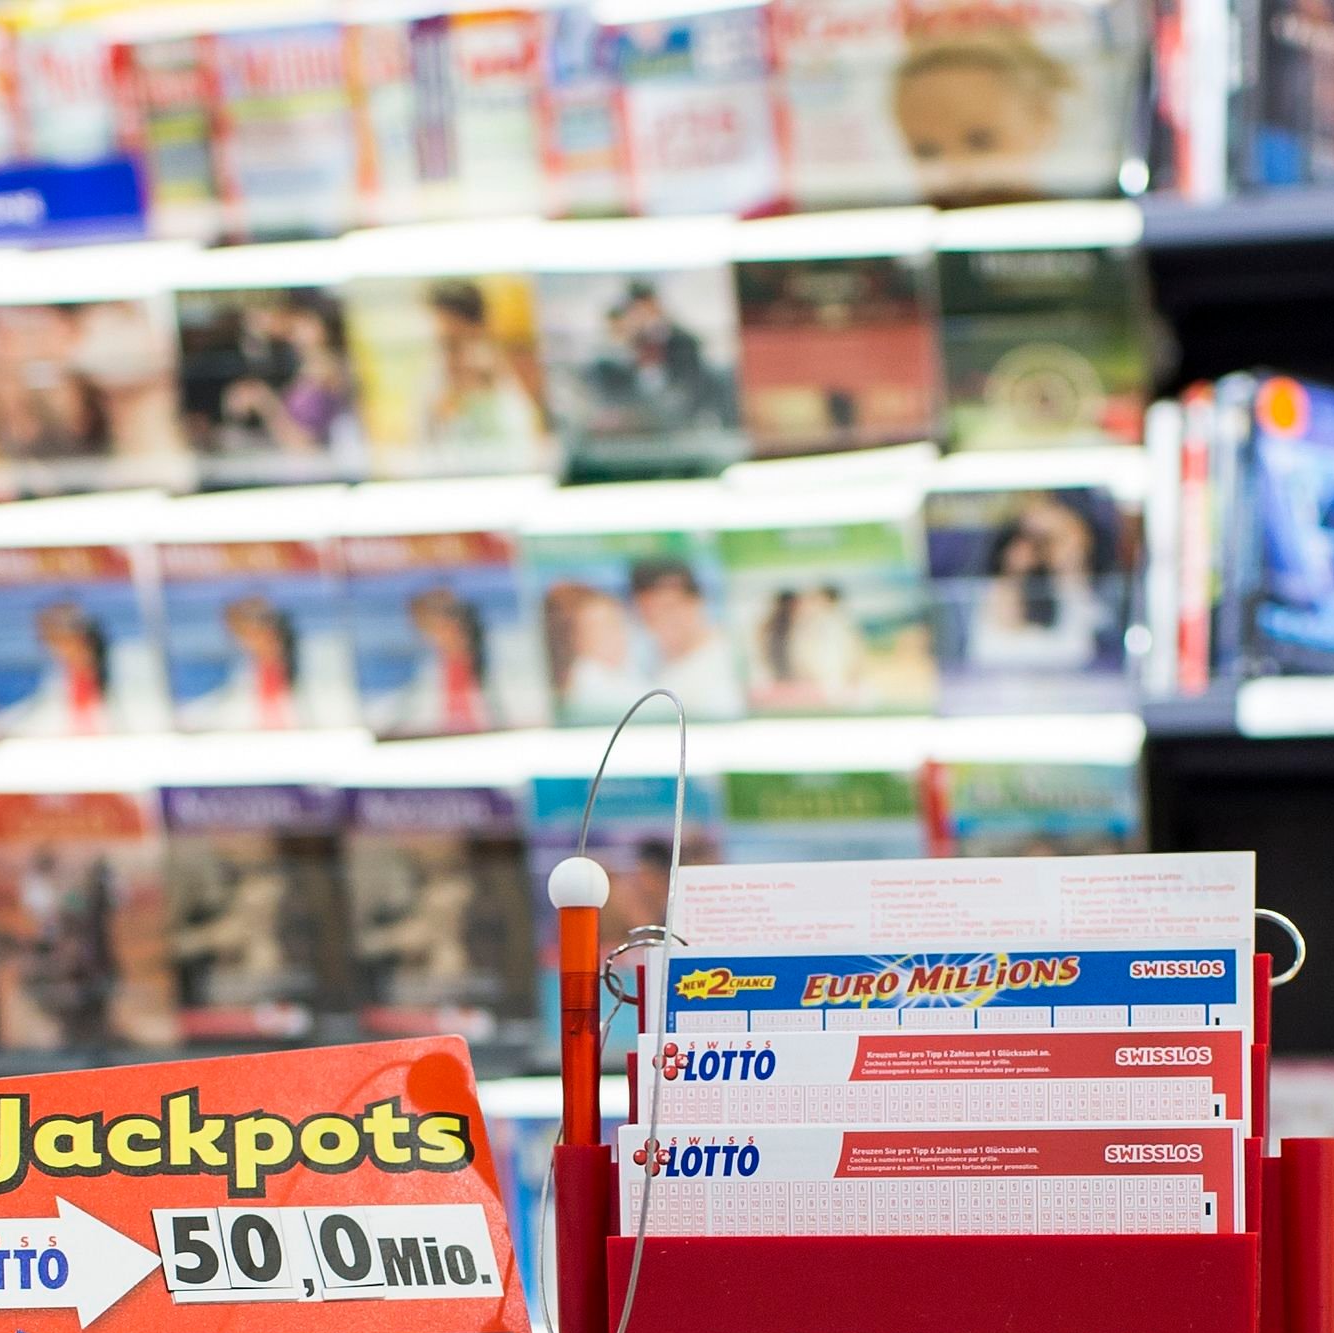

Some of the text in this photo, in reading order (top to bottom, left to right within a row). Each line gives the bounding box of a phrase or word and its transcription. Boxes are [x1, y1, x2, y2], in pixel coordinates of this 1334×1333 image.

[682, 969, 773, 995] NEW 2 CHANCE
[801, 971, 900, 1004] EURO
[1131, 961, 1224, 978] SWISSLOS
[689, 1040, 771, 1050] SWISS
[927, 1051, 942, 1060] Tipp
[949, 1050, 974, 1058] Zahlen
[1116, 1047, 1212, 1065] SWISSLOS
[683, 1049, 776, 1081] LOTTO
[670, 1136, 755, 1146] SWISS
[852, 1147, 883, 1155] Kreuzen
[884, 1147, 896, 1155] Sie
[912, 1147, 929, 1156] Tipp
[936, 1146, 961, 1154] Zahlen
[963, 1146, 977, 1154] und
[1105, 1144, 1202, 1163] SWISSLOS
[665, 1145, 760, 1177] LOTTO
[377, 1236, 492, 1288] Mio.
